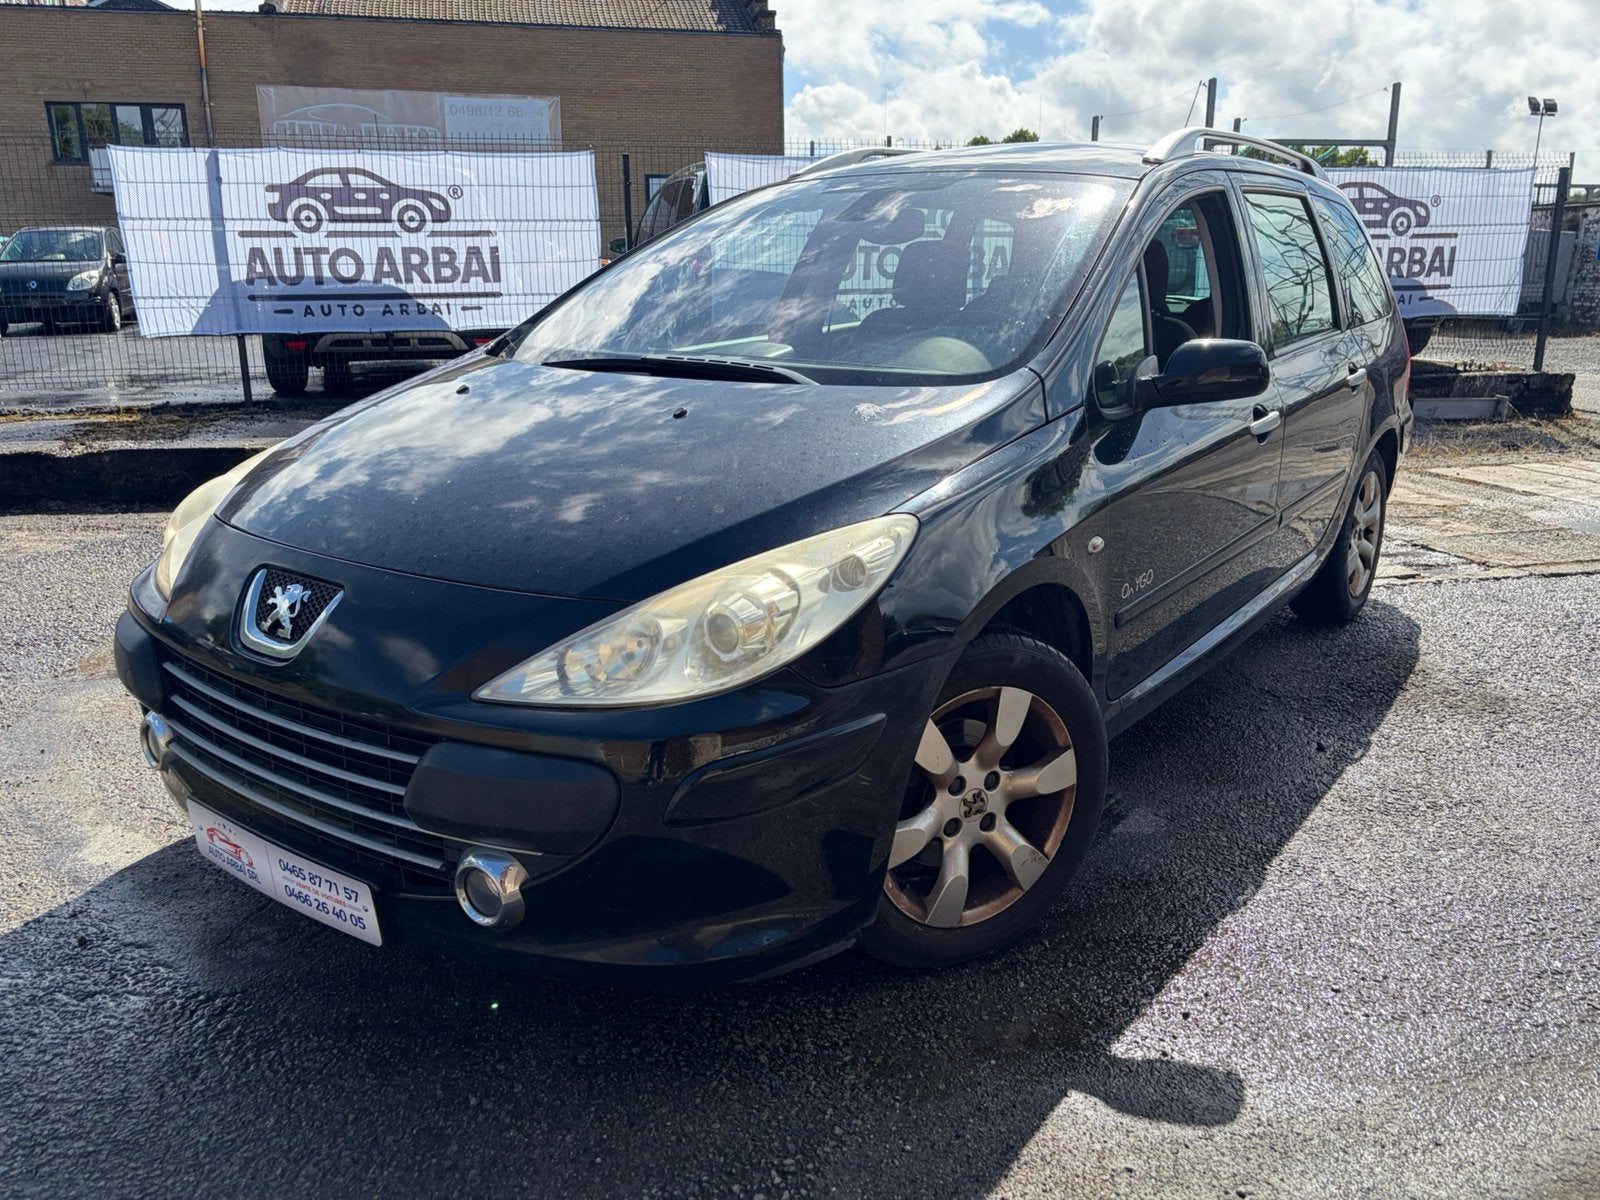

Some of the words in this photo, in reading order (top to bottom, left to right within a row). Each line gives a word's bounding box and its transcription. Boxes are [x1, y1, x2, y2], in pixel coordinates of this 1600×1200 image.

[245, 246, 365, 286] AUTO
[372, 245, 502, 285] ARBAI
[302, 303, 366, 318] AUTO
[381, 302, 451, 317] ARBAI
[208, 844, 226, 863] AUTO
[246, 868, 262, 885] SRL
[278, 858, 307, 881] 0465
[308, 871, 322, 888] 87
[324, 878, 340, 896] 71
[343, 886, 359, 903] 57
[284, 884, 313, 907] 0466
[313, 898, 330, 915] 26
[331, 906, 348, 922] 40
[349, 913, 367, 930] 05
